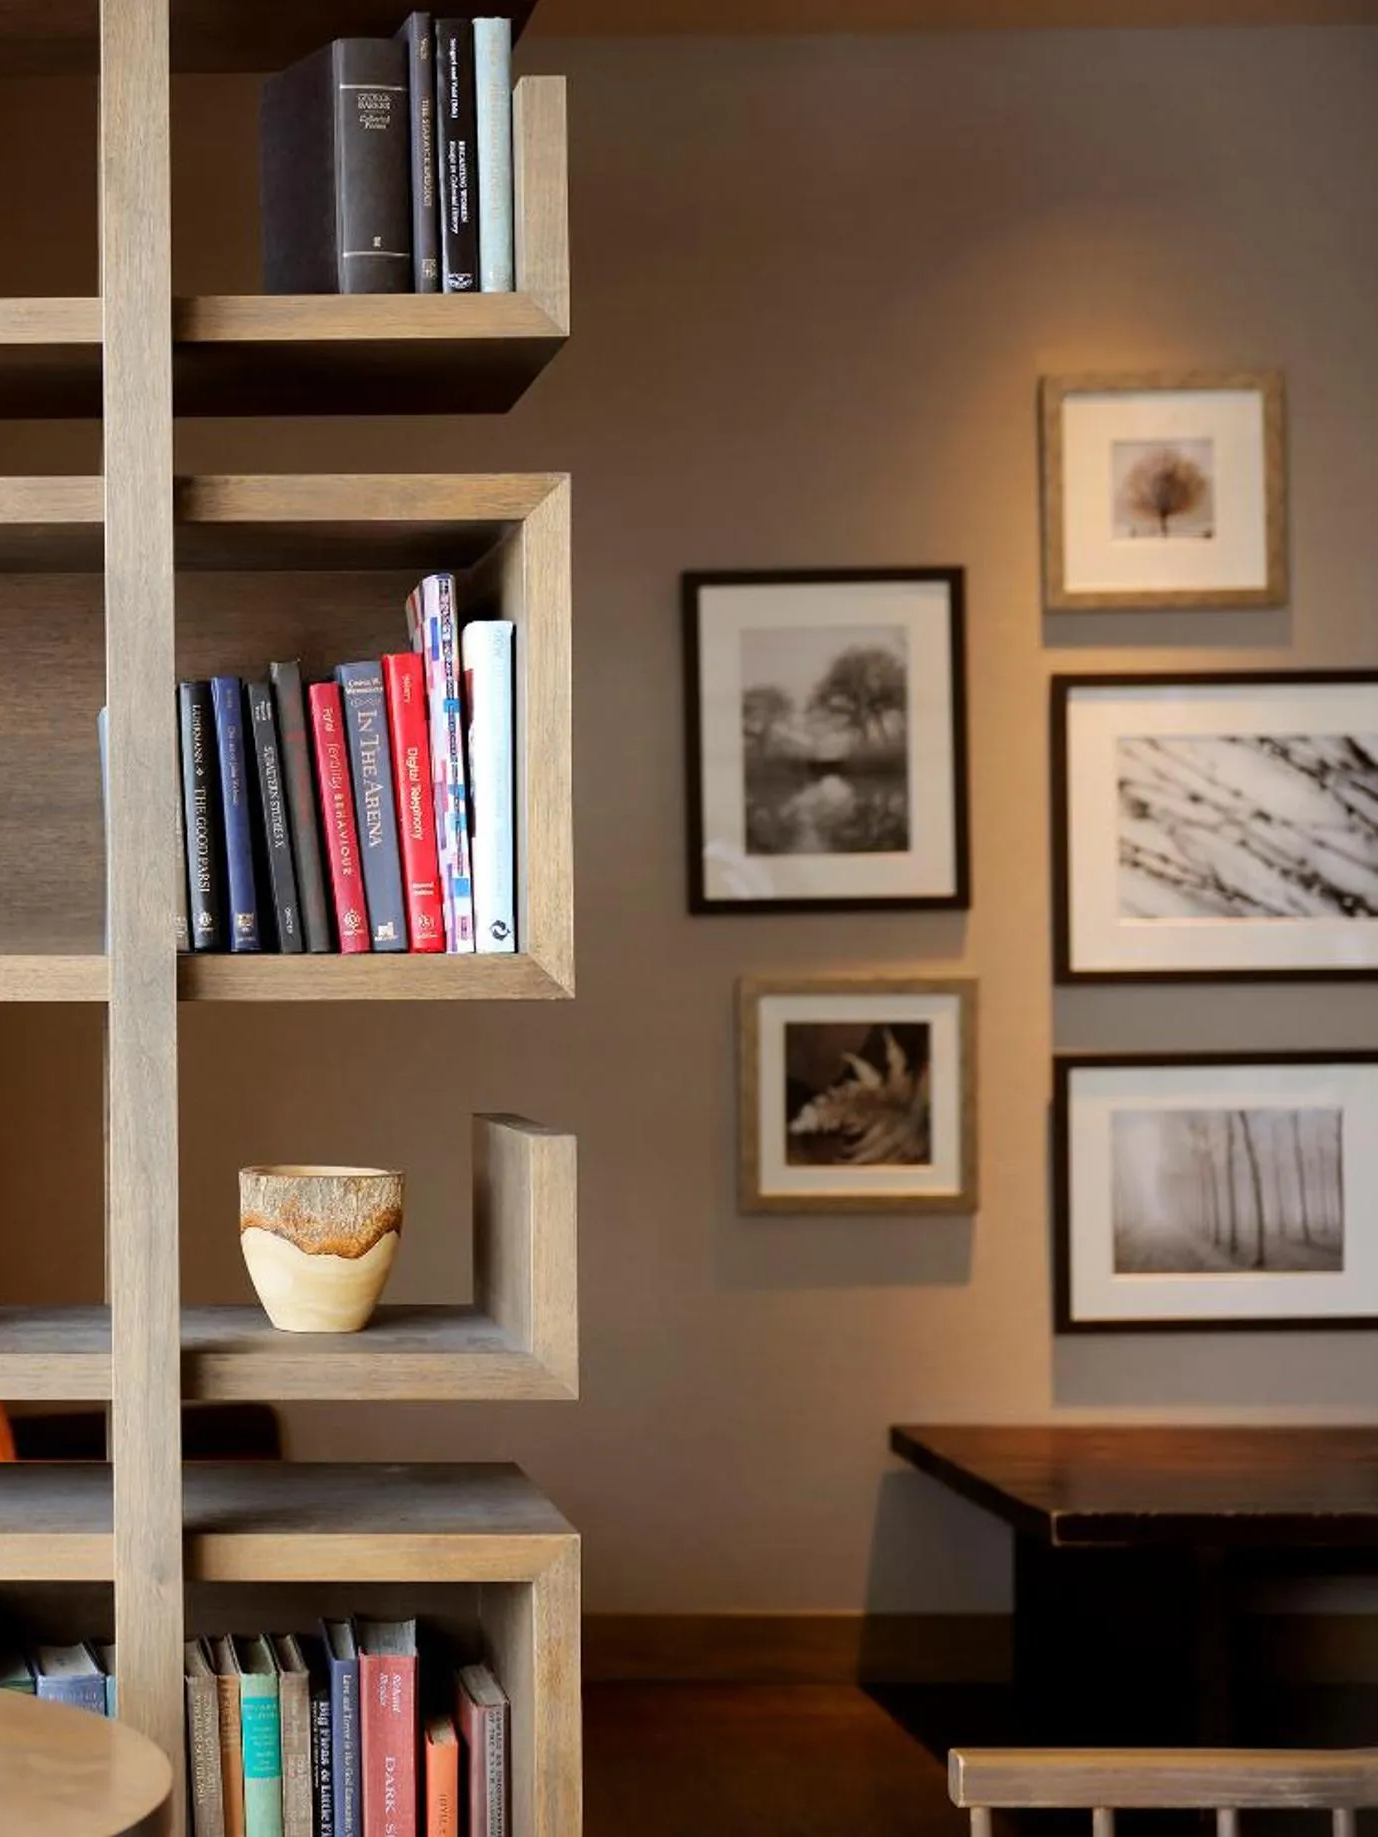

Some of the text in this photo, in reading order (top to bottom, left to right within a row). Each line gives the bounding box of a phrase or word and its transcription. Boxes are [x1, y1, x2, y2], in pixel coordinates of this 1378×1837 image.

[192, 704, 202, 763] LUHRMANN
[358, 710, 384, 848] IN THE ARENA
[406, 747, 423, 841] Digital Telephony
[194, 786, 210, 892] THE GOOD PARSI
[270, 801, 283, 839] STUDIES
[333, 794, 352, 876] BEHAVIOUR
[343, 1674, 351, 1695] Love
[318, 1700, 330, 1727] Big
[343, 1697, 352, 1712] and
[342, 1713, 352, 1742] Terror
[321, 1768, 331, 1783] &
[344, 1752, 353, 1767] the
[344, 1768, 353, 1785] God
[321, 1784, 332, 1824] Little
[385, 1757, 397, 1814] DARK
